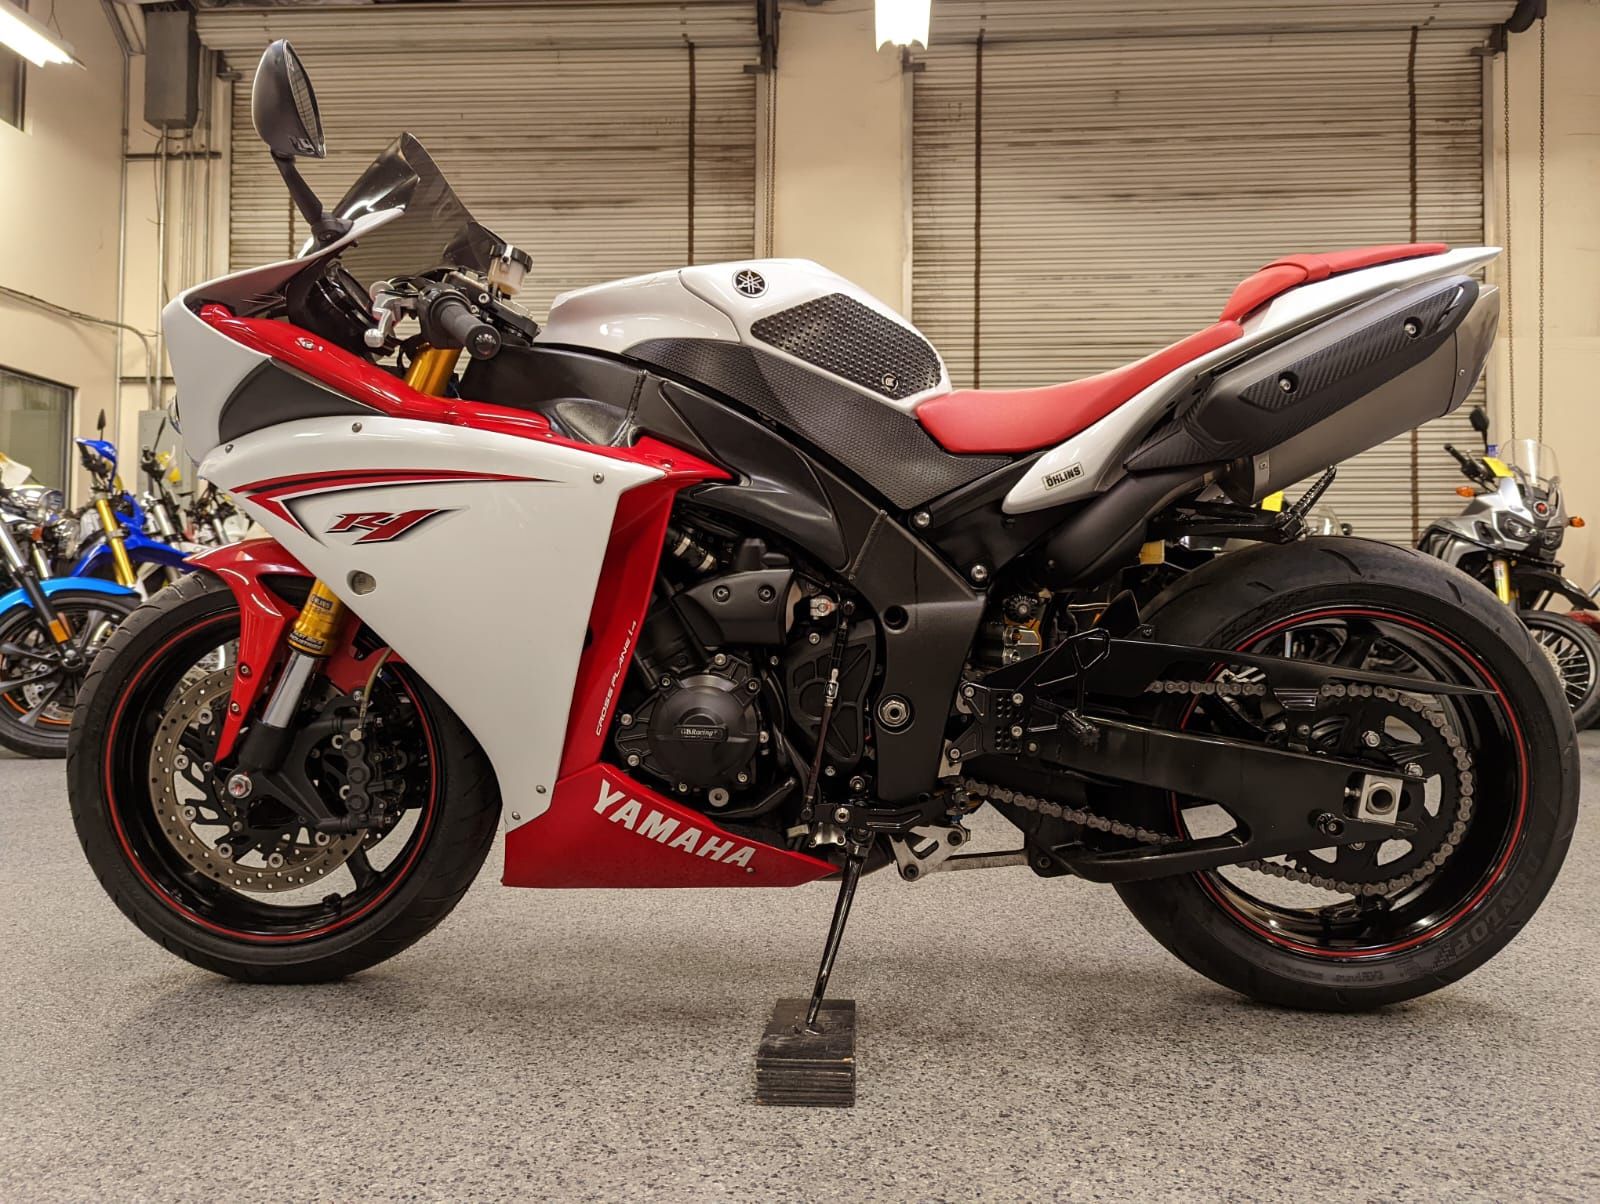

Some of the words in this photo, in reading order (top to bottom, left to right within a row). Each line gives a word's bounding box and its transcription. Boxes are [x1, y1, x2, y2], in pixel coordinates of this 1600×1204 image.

[1045, 466, 1081, 487] ÖHLINS
[326, 508, 442, 543] R1
[596, 687, 614, 736] CROSS
[611, 638, 631, 687] PLANE
[593, 778, 756, 867] YAMAHA
